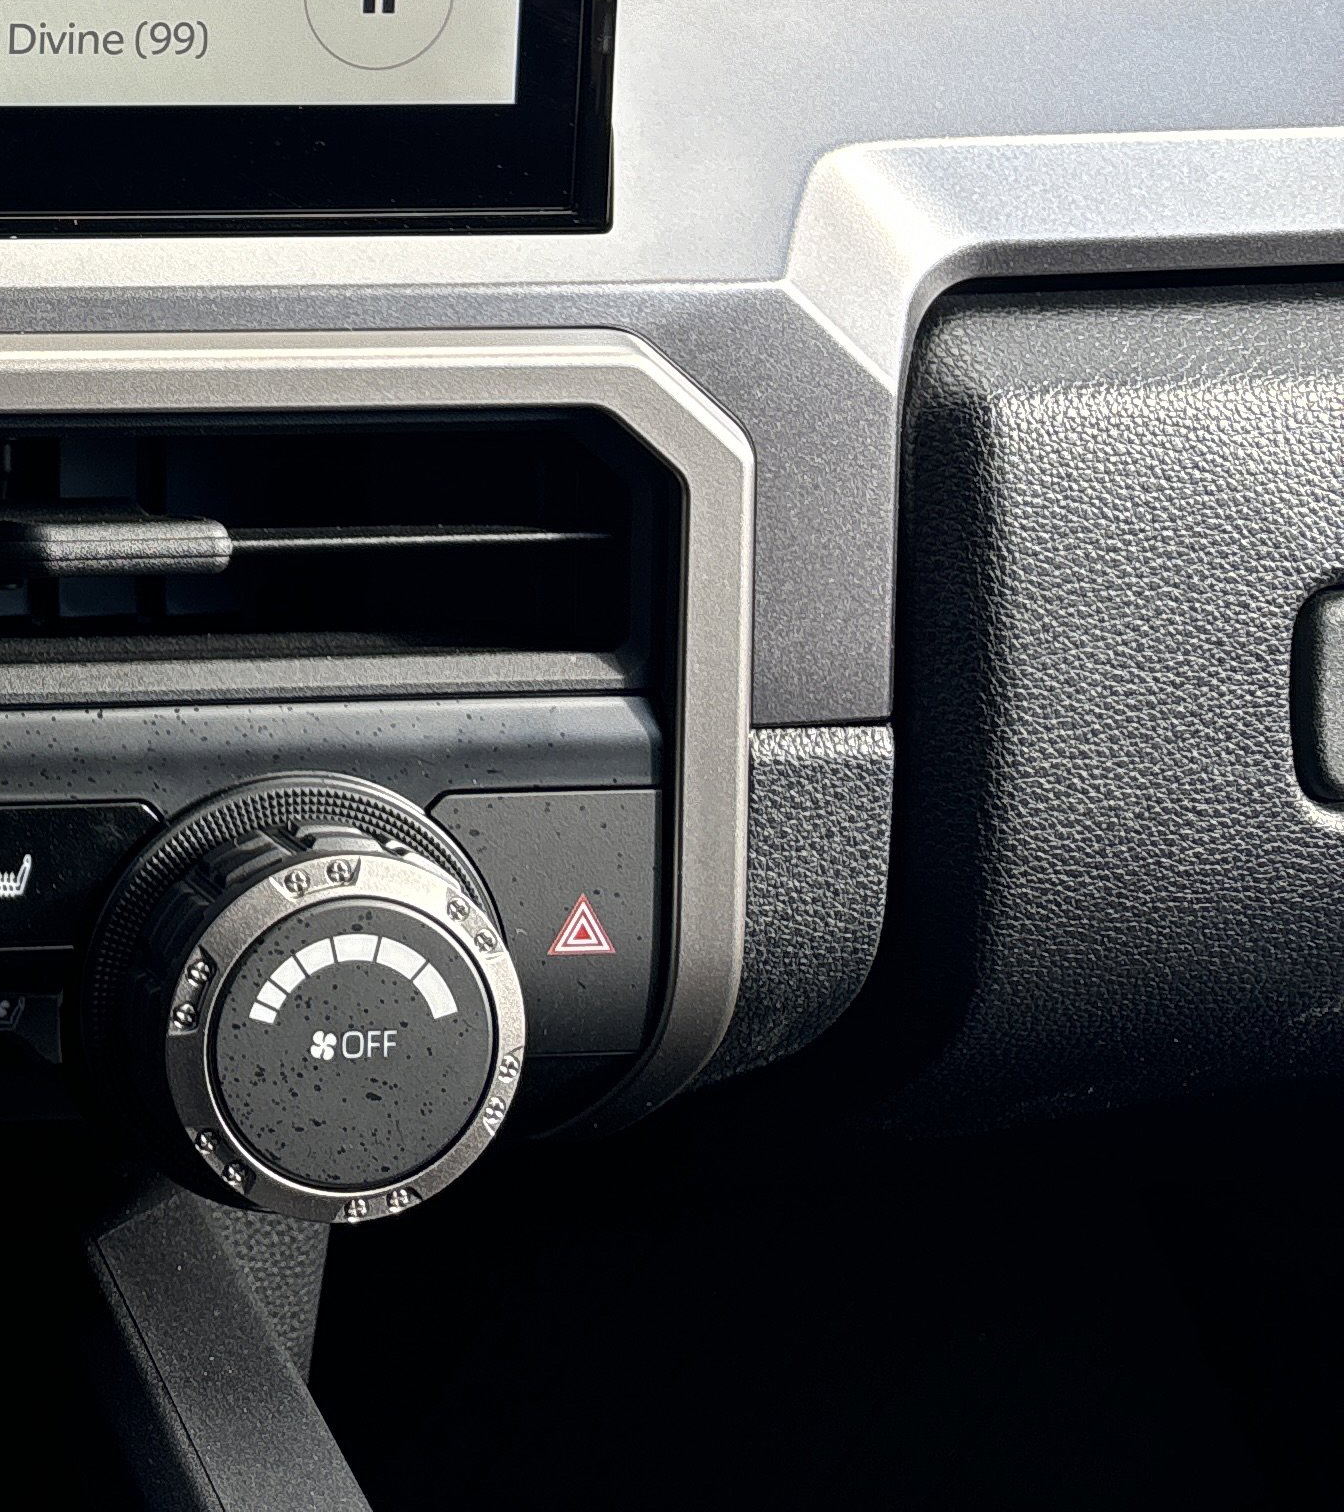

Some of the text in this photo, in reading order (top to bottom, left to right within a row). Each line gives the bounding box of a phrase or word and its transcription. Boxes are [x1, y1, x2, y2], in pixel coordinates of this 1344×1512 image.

[9, 22, 124, 55] Divine
[135, 21, 207, 59] (99)
[342, 1031, 397, 1058] OFF
